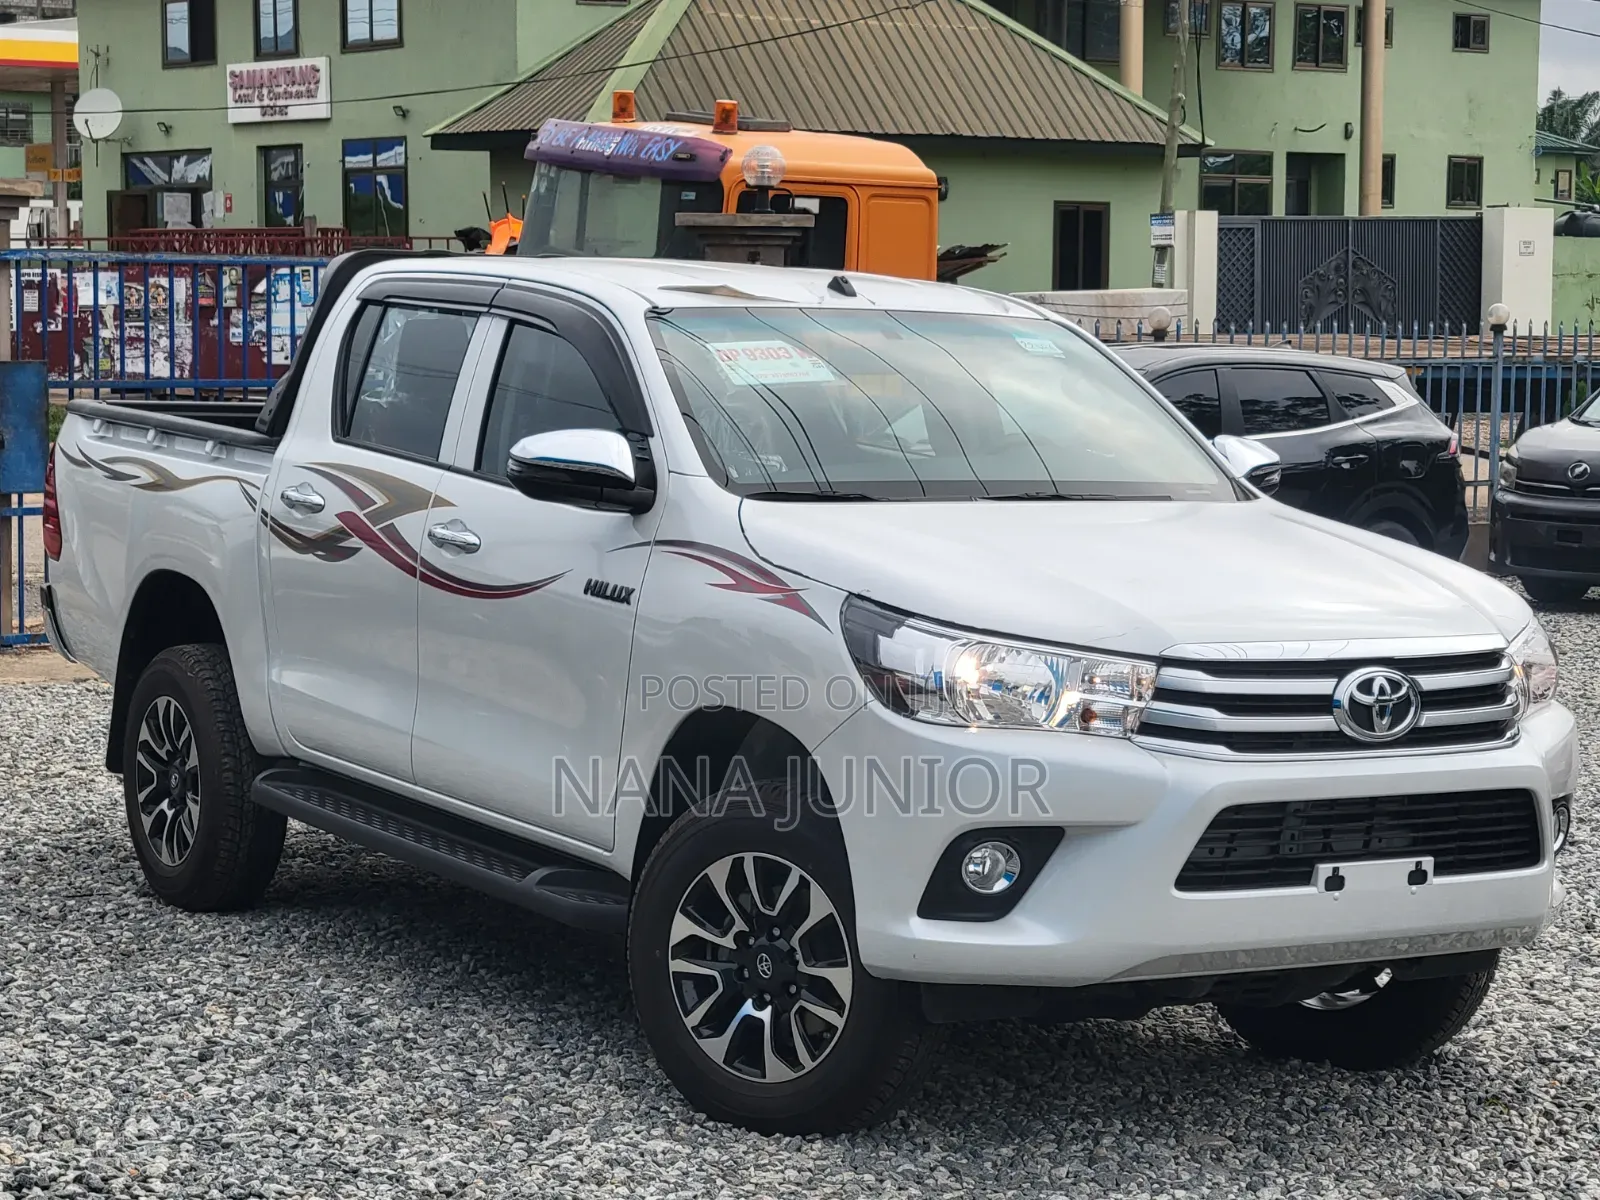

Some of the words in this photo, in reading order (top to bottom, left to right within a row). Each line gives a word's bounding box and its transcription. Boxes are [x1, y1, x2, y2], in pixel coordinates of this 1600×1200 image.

[229, 65, 320, 89] SAMARITANS
[640, 135, 683, 162] EASY
[741, 346, 793, 361] 9303
[584, 578, 635, 606] HILUX
